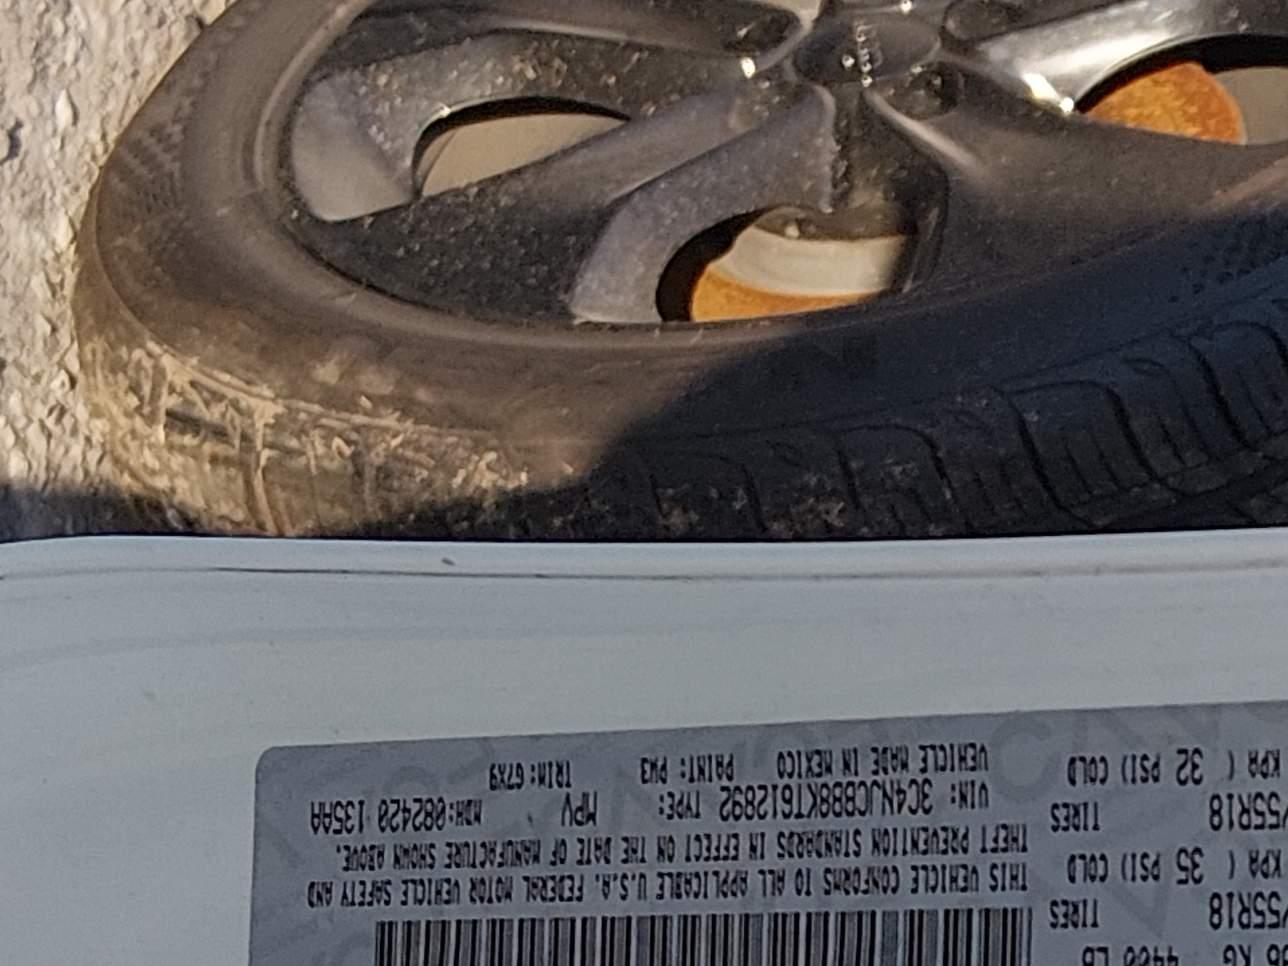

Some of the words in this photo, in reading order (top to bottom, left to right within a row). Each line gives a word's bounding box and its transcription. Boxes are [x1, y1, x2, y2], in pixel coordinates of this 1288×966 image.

[680, 754, 733, 783] PAINT:
[777, 749, 832, 779] MEXICO
[842, 748, 858, 776] IN
[871, 746, 908, 775] MADE
[919, 743, 988, 774] VEHICLE
[1068, 756, 1108, 786] COLD
[1121, 754, 1160, 784] PSI)
[1176, 748, 1203, 786] 32
[1248, 749, 1280, 779] KPA
[531, 761, 571, 789] TRIM:
[562, 792, 597, 826] MPV
[659, 790, 700, 820] TYPE:
[718, 777, 933, 822] 3C4NJCBB8KT612892
[951, 780, 988, 809] VIN:
[311, 800, 365, 835] 135AA
[1051, 802, 1100, 832] TIRES
[550, 839, 567, 866] OF
[576, 837, 611, 865] DATE
[621, 836, 646, 864] THE
[657, 835, 675, 863] ON
[685, 833, 739, 862] EFFECT
[749, 832, 765, 860] IN
[777, 828, 861, 859] STANDARDS
[872, 826, 969, 856] PREVENTION
[980, 824, 1028, 853] THEFT
[336, 845, 384, 872] ABOVE.
[393, 843, 435, 869] SHOWN
[444, 840, 540, 868] MANUFACTURE
[1067, 853, 1108, 884] COLD
[1121, 852, 1160, 882] PSI)
[1176, 847, 1204, 885] 35
[1249, 850, 1281, 879] KPA
[469, 877, 513, 904] MOTOR
[523, 875, 584, 902] FEDERAL
[595, 872, 647, 901] U.S.A.
[656, 870, 748, 900] APPLICABLE
[758, 869, 785, 897] ALL
[795, 868, 811, 896] TO
[824, 866, 900, 895] CONFORMS
[911, 864, 979, 894] VEHICLE
[989, 862, 1027, 892] THIS
[308, 881, 333, 908] AND
[341, 880, 392, 907] SAFETY
[401, 878, 460, 906] VEHICLE
[1050, 899, 1099, 929] TIRES
